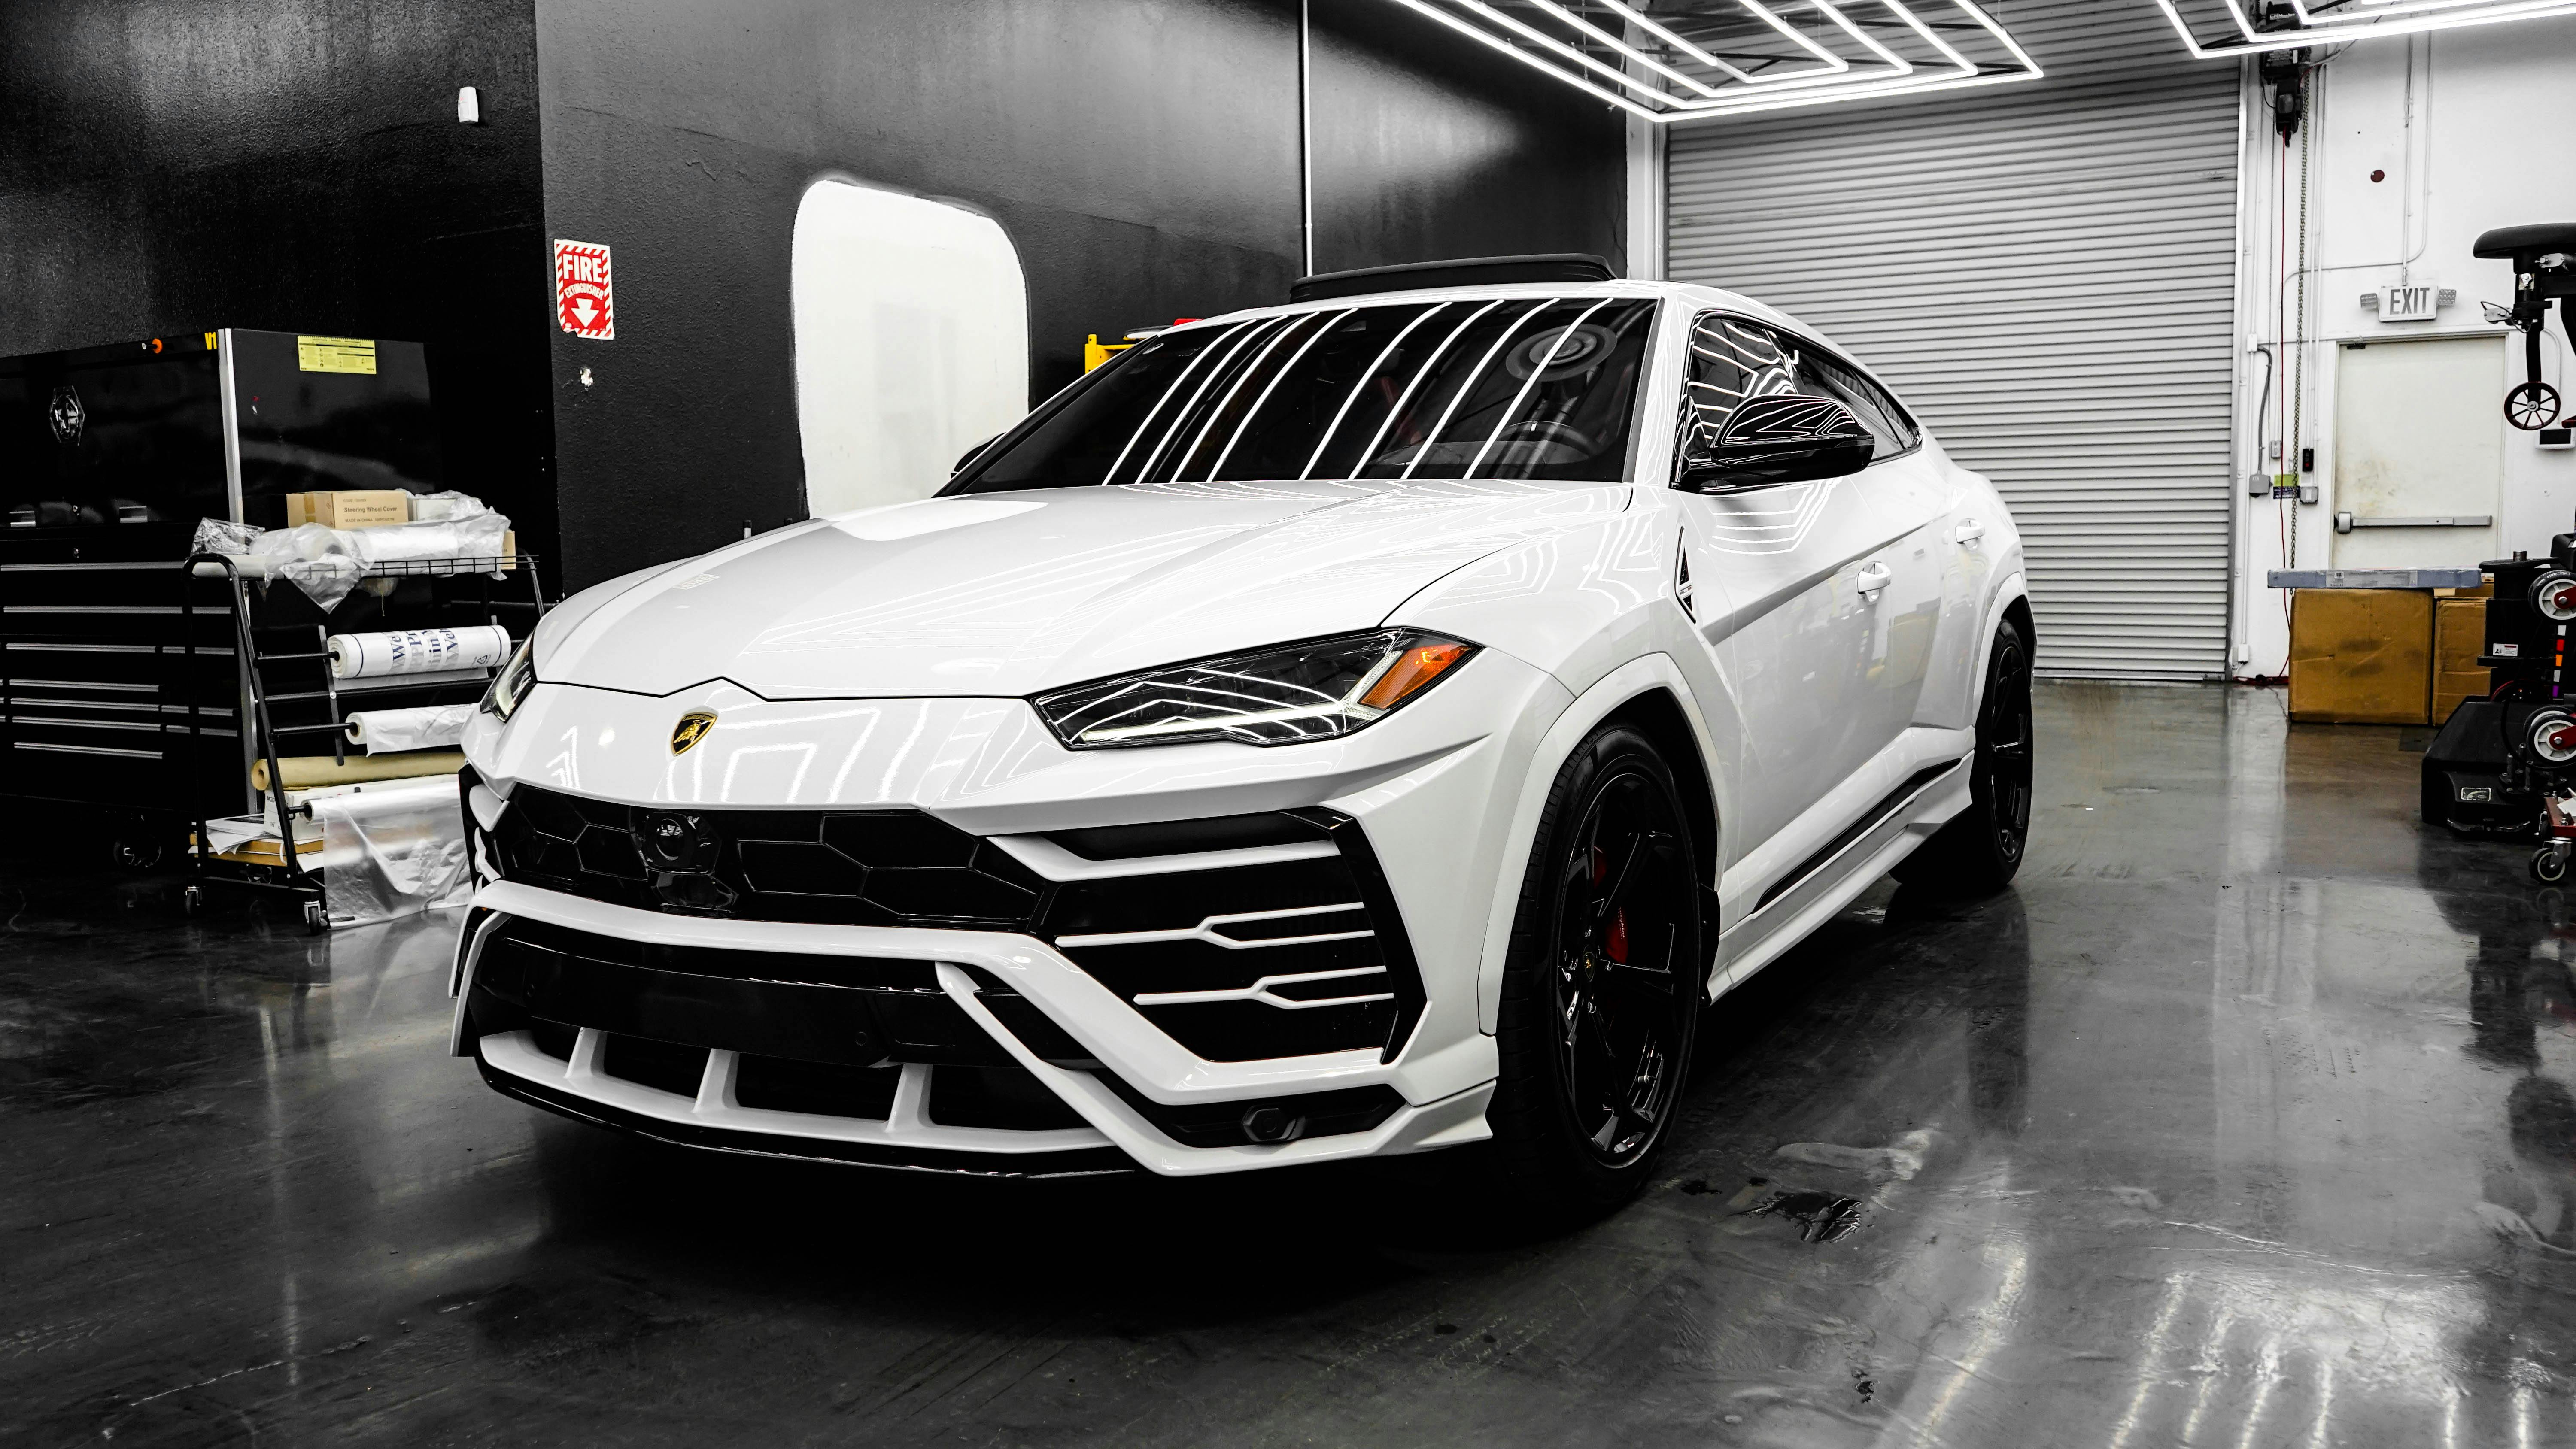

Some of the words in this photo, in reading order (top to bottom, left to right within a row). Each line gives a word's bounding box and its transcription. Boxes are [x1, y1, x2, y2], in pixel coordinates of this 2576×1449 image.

[563, 253, 604, 283] FIRE
[564, 283, 604, 300] EXTINGUISHER
[2390, 287, 2430, 315] EXIT
